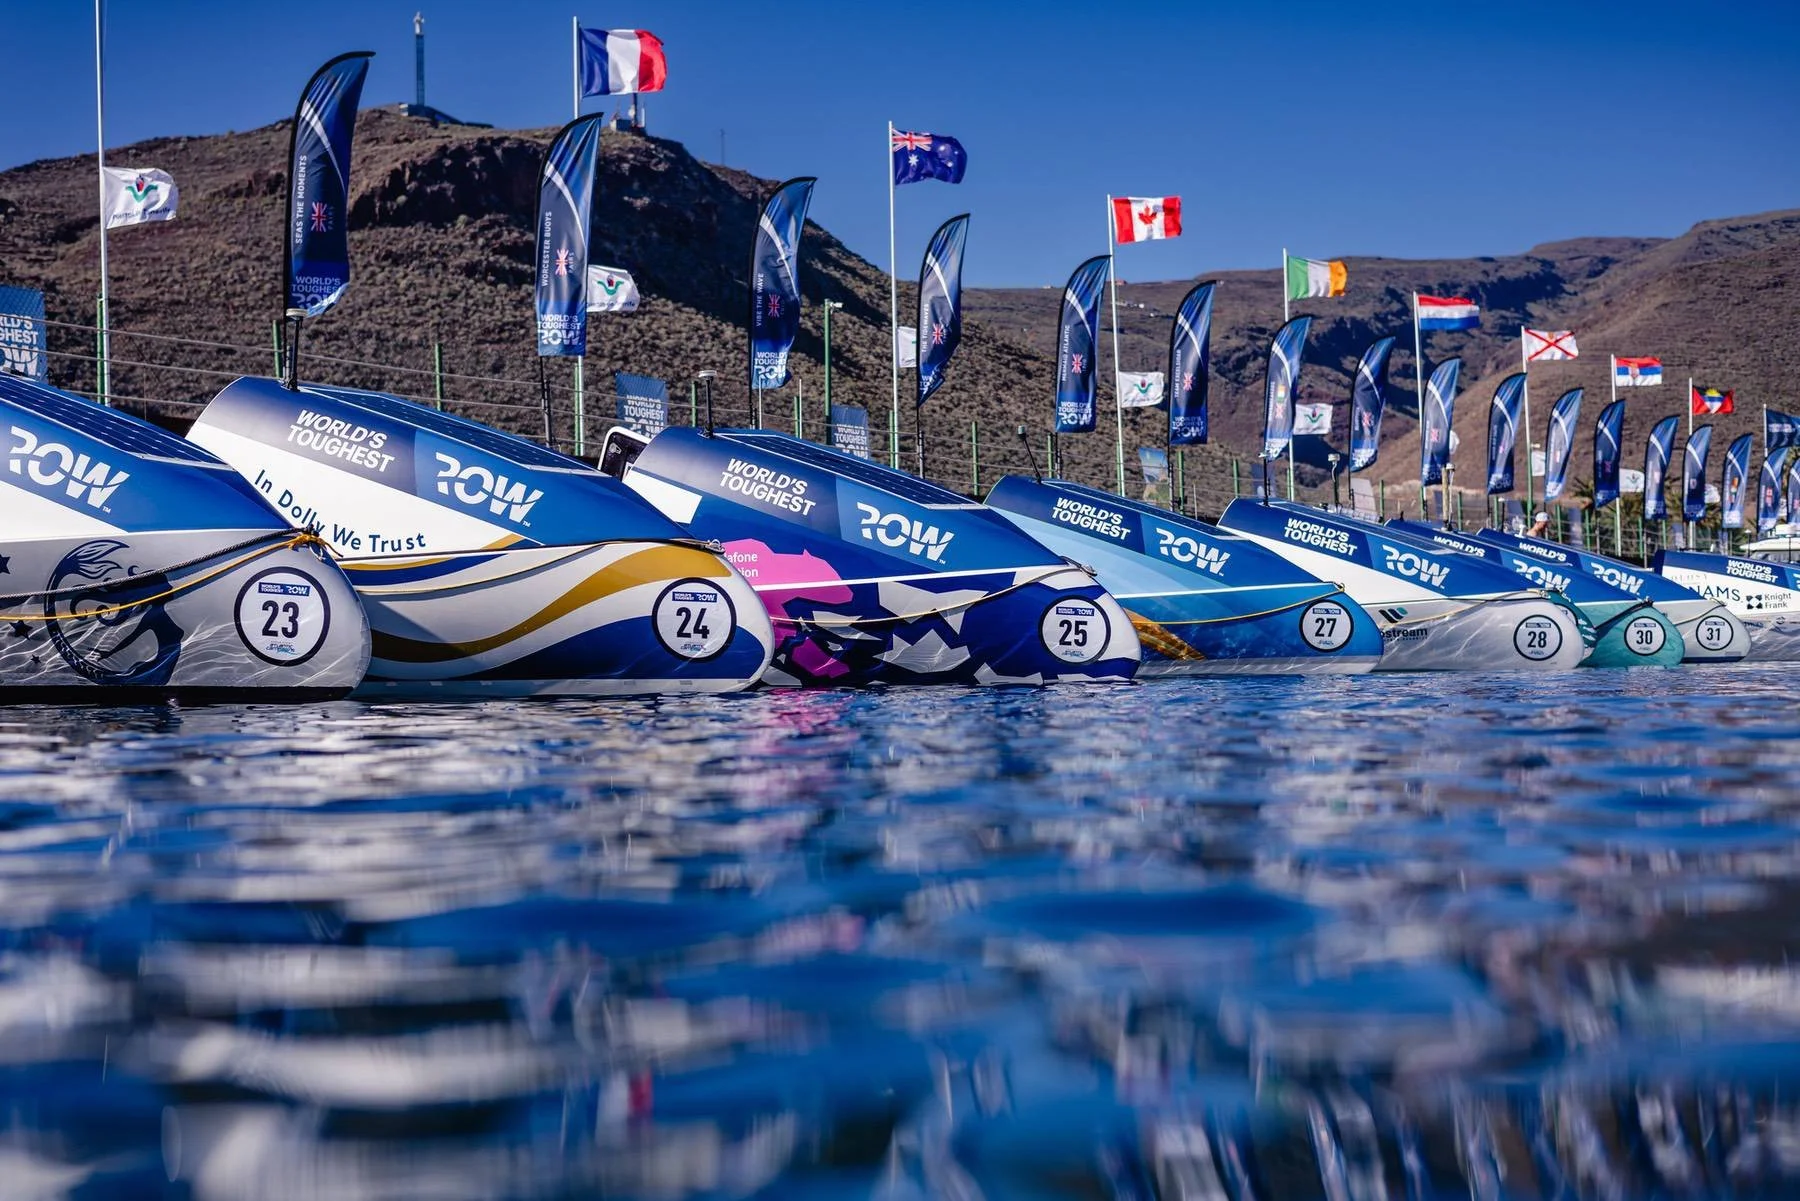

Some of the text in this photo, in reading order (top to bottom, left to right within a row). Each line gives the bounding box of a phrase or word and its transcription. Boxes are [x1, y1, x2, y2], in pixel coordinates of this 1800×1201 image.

[295, 155, 307, 244] SEAS THE MOMENTS
[541, 211, 552, 287] WORCESTER BUOYS
[291, 284, 340, 294] TOUGHES
[295, 276, 341, 286] WORLD'S
[537, 321, 581, 330] TOUGHEST
[541, 314, 578, 323] WORLD'S
[537, 330, 580, 345] ROW
[623, 405, 665, 421] TOUGHEST
[627, 395, 661, 409] WORLD'S
[296, 409, 388, 449] WORLD'S
[1058, 413, 1092, 425] ROW
[287, 424, 396, 473] TOUGHEST
[834, 433, 868, 445] TOUGHEST
[9, 425, 130, 509] ROW
[727, 458, 808, 495] WORLD'S
[435, 451, 545, 523] ROW
[719, 471, 817, 516] TOUGHEST
[254, 469, 427, 553] In Dolly We Trust
[1051, 506, 1131, 540] TOUGHEST
[1056, 497, 1123, 525] WORLD'S
[857, 501, 955, 562] ROW
[1283, 527, 1358, 556] TOUGHEST
[1287, 518, 1350, 542] WORLD'S
[1156, 527, 1231, 575] ROW
[1433, 535, 1486, 558] WORLD'S
[1519, 542, 1567, 562] WORLD'S
[1382, 544, 1451, 588] ROW
[1513, 559, 1571, 592] ROW
[1726, 567, 1779, 583] TOUGHEST
[1728, 559, 1772, 574] WORLD'S
[286, 585, 308, 595] ROW
[1590, 562, 1644, 595] ROW
[696, 593, 716, 602] ROW
[1764, 593, 1792, 603] Knight
[261, 600, 300, 639] 23
[676, 606, 710, 639] 24
[1314, 617, 1337, 637] 27
[1059, 619, 1088, 647] 25
[1527, 631, 1547, 648] 28
[1636, 630, 1653, 645] 30
[1706, 627, 1721, 641] 31
